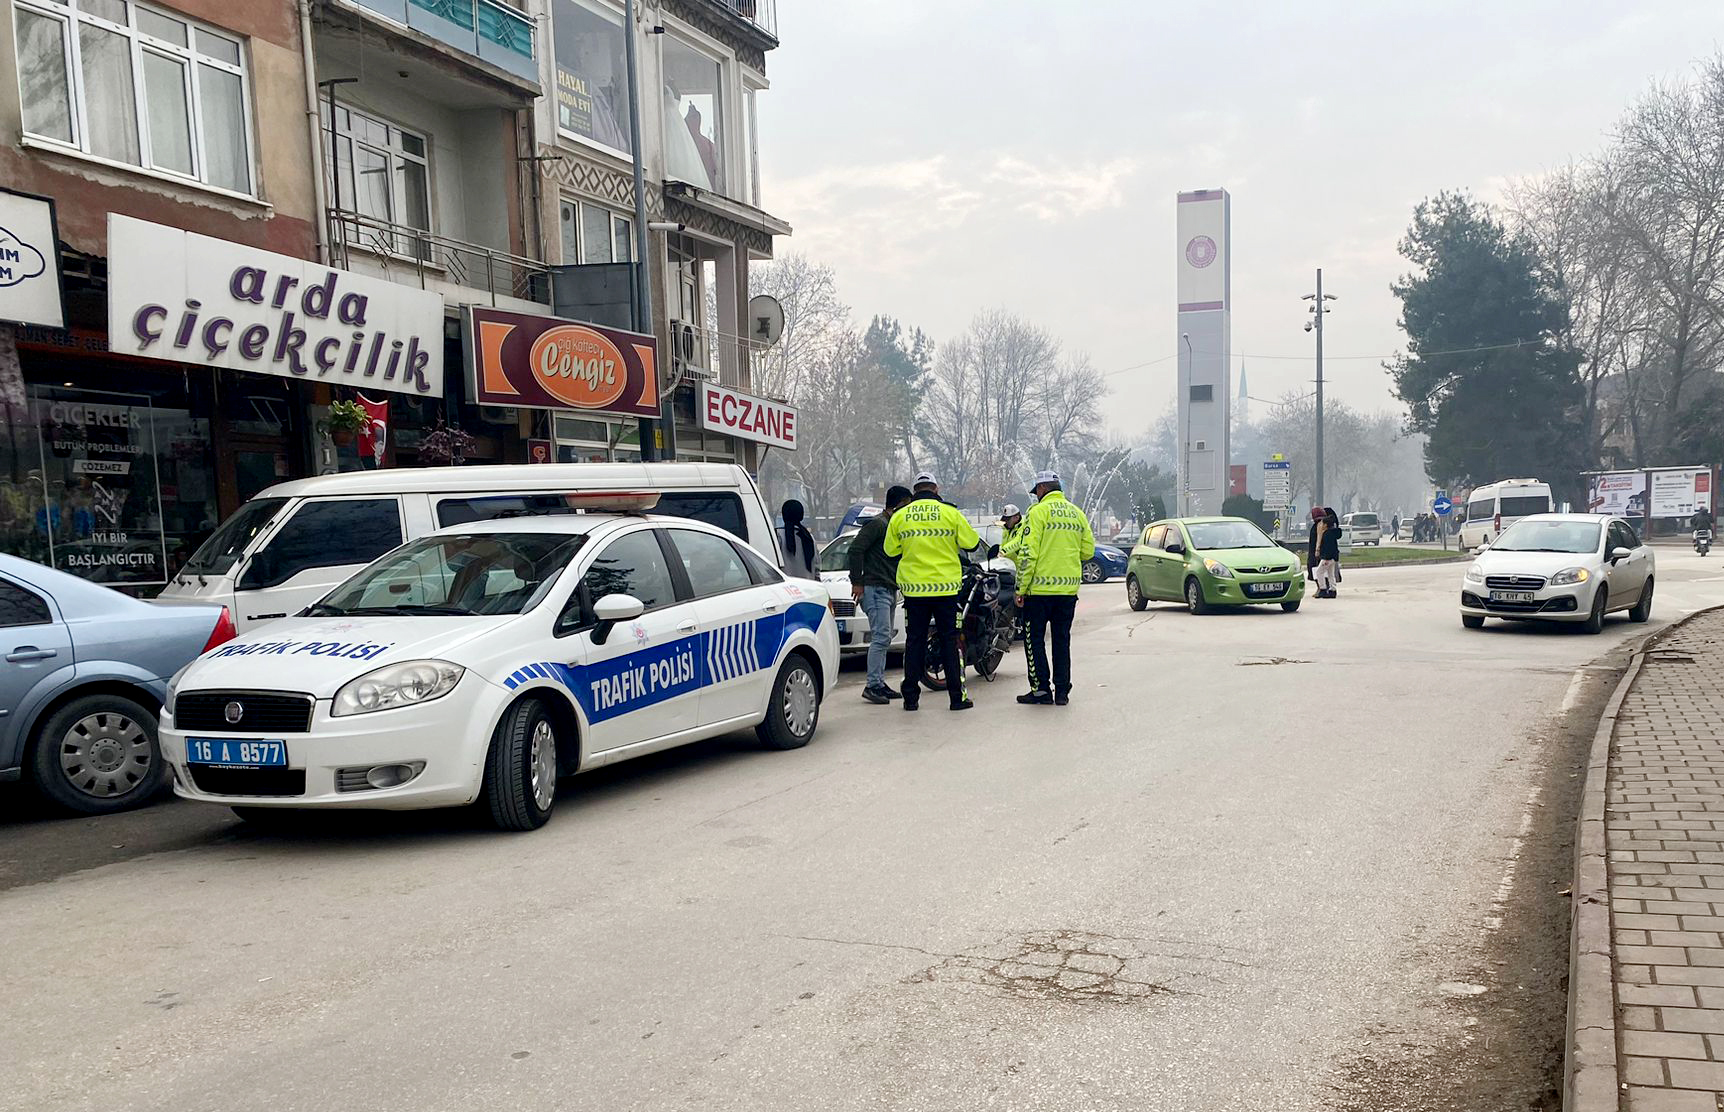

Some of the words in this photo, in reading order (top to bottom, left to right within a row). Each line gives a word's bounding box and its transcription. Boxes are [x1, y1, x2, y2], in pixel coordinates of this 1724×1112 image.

[558, 69, 592, 97] HAYAL
[229, 265, 369, 327] arda
[132, 298, 431, 393] çiçekçilik
[541, 342, 615, 392] Cengiz
[707, 390, 794, 442] ECZANE
[905, 512, 941, 522] POLİSİ
[907, 504, 940, 513] TRAFİK
[92, 530, 107, 543] İYİ
[109, 530, 128, 543] BİR
[68, 553, 155, 568] BAŞLANGIÇTIR
[207, 639, 302, 660] TRAFİK
[291, 641, 395, 661] POLİSİ
[591, 660, 647, 712] TRAFİK
[649, 642, 694, 693] POLİSİ
[195, 741, 212, 760] 16
[222, 742, 231, 762] A
[240, 743, 280, 763] 8577
